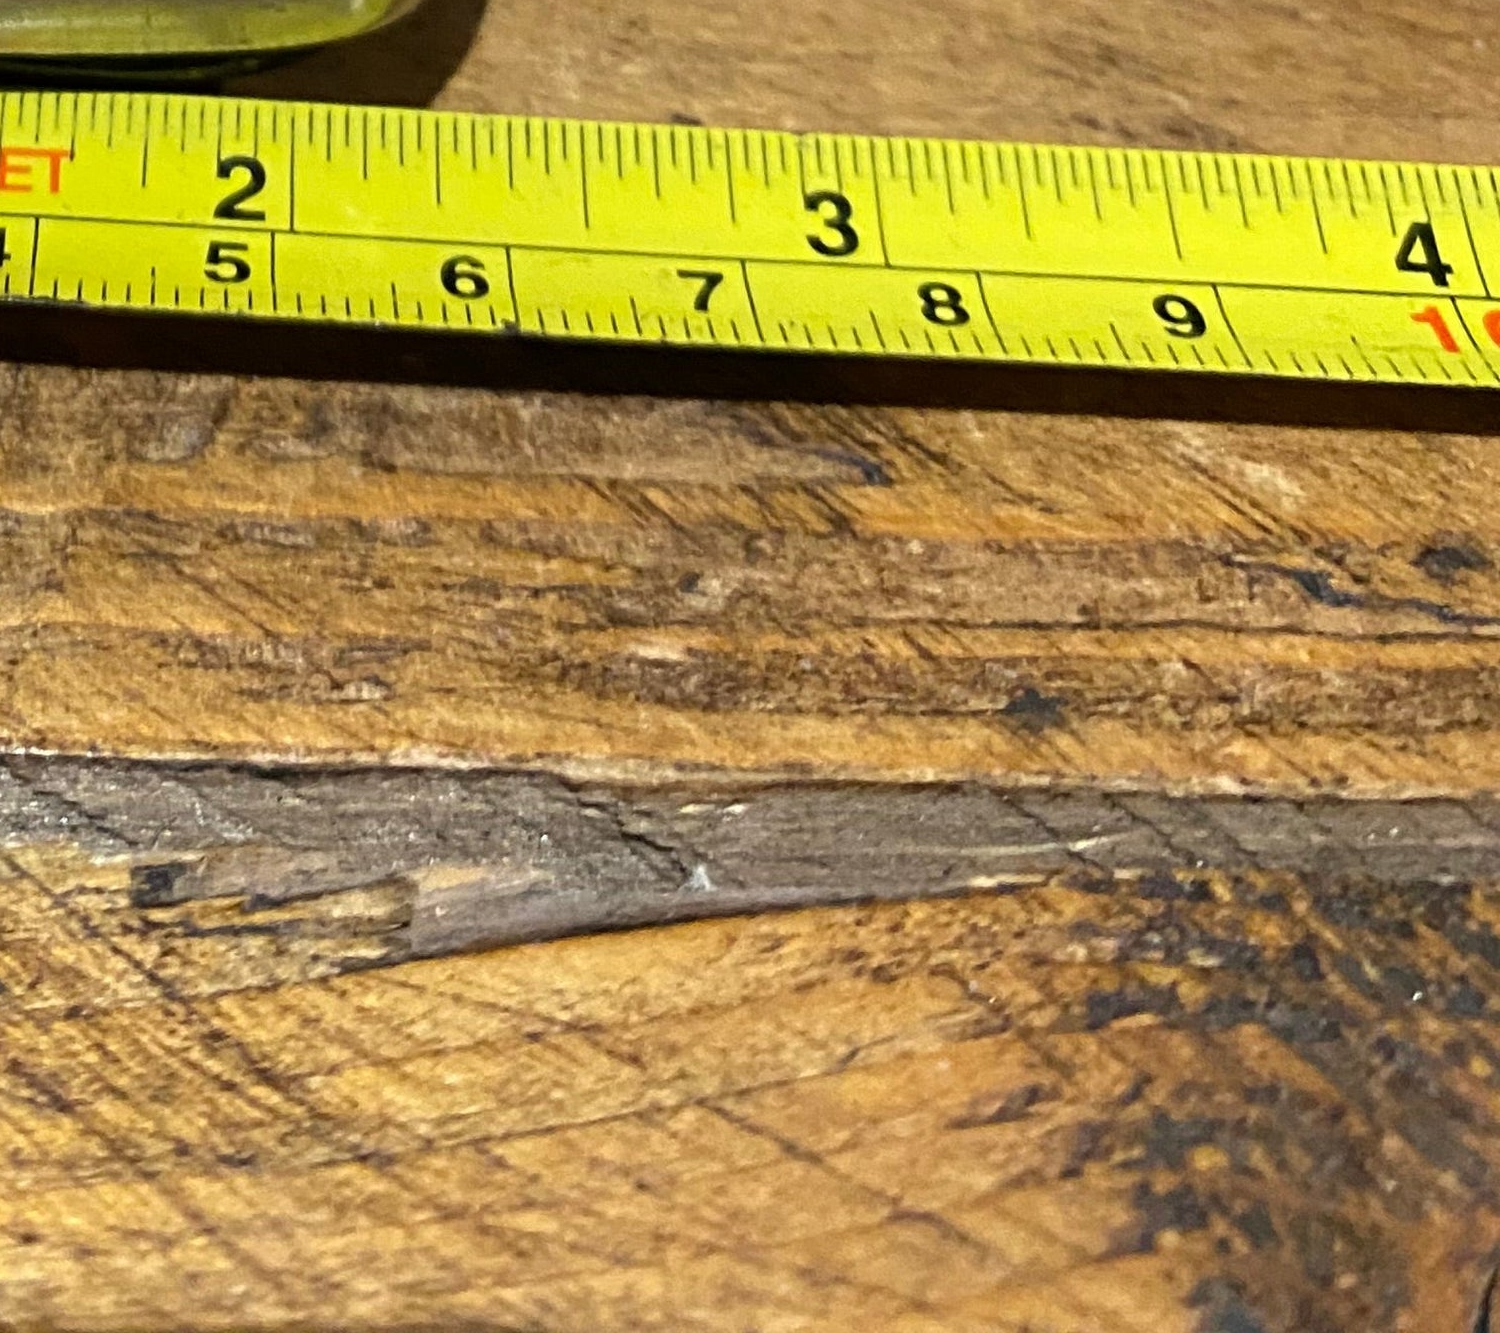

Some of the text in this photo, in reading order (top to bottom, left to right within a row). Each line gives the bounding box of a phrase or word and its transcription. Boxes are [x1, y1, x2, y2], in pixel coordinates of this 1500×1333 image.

[213, 155, 268, 221] 2
[804, 190, 860, 257] 3
[1395, 222, 1453, 287] 4
[203, 241, 252, 284] 5
[439, 256, 490, 300] 6
[676, 271, 724, 312] 7
[918, 282, 971, 327] 8
[1153, 295, 1207, 338] 9
